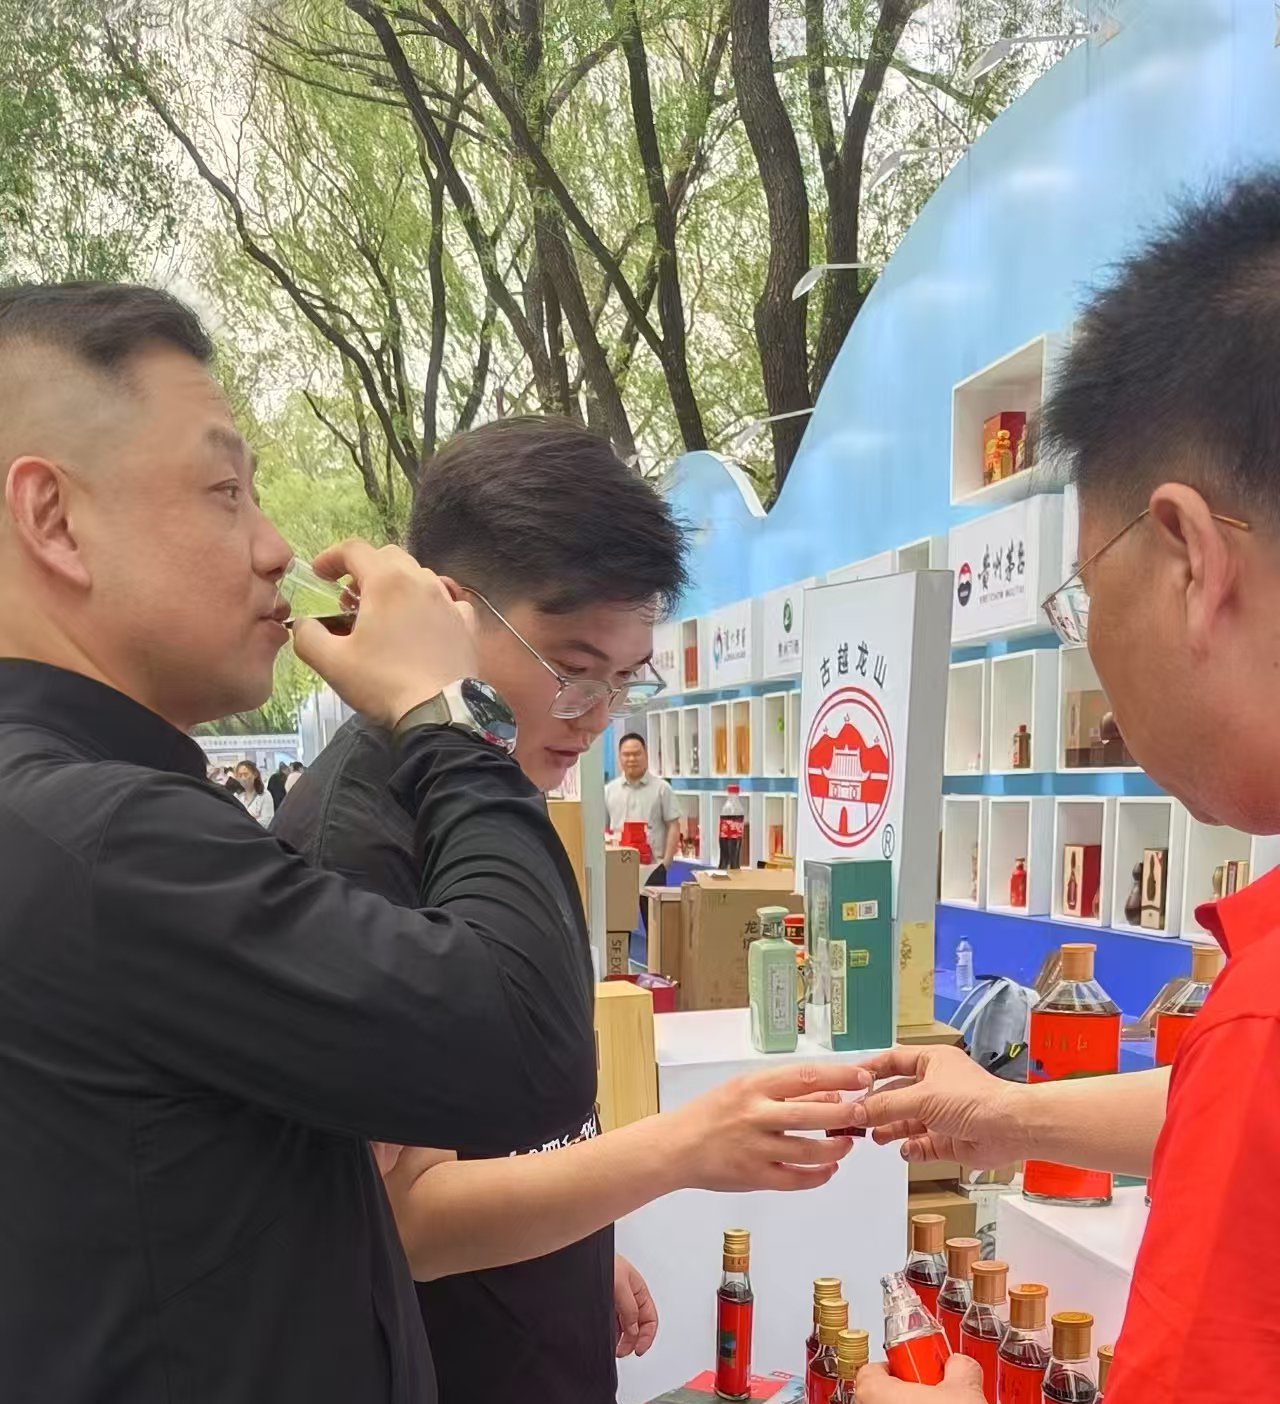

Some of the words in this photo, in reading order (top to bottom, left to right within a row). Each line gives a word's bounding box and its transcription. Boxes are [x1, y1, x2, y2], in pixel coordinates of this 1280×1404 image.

[820, 640, 888, 689] 古越龙山
[611, 939, 622, 955] SF
